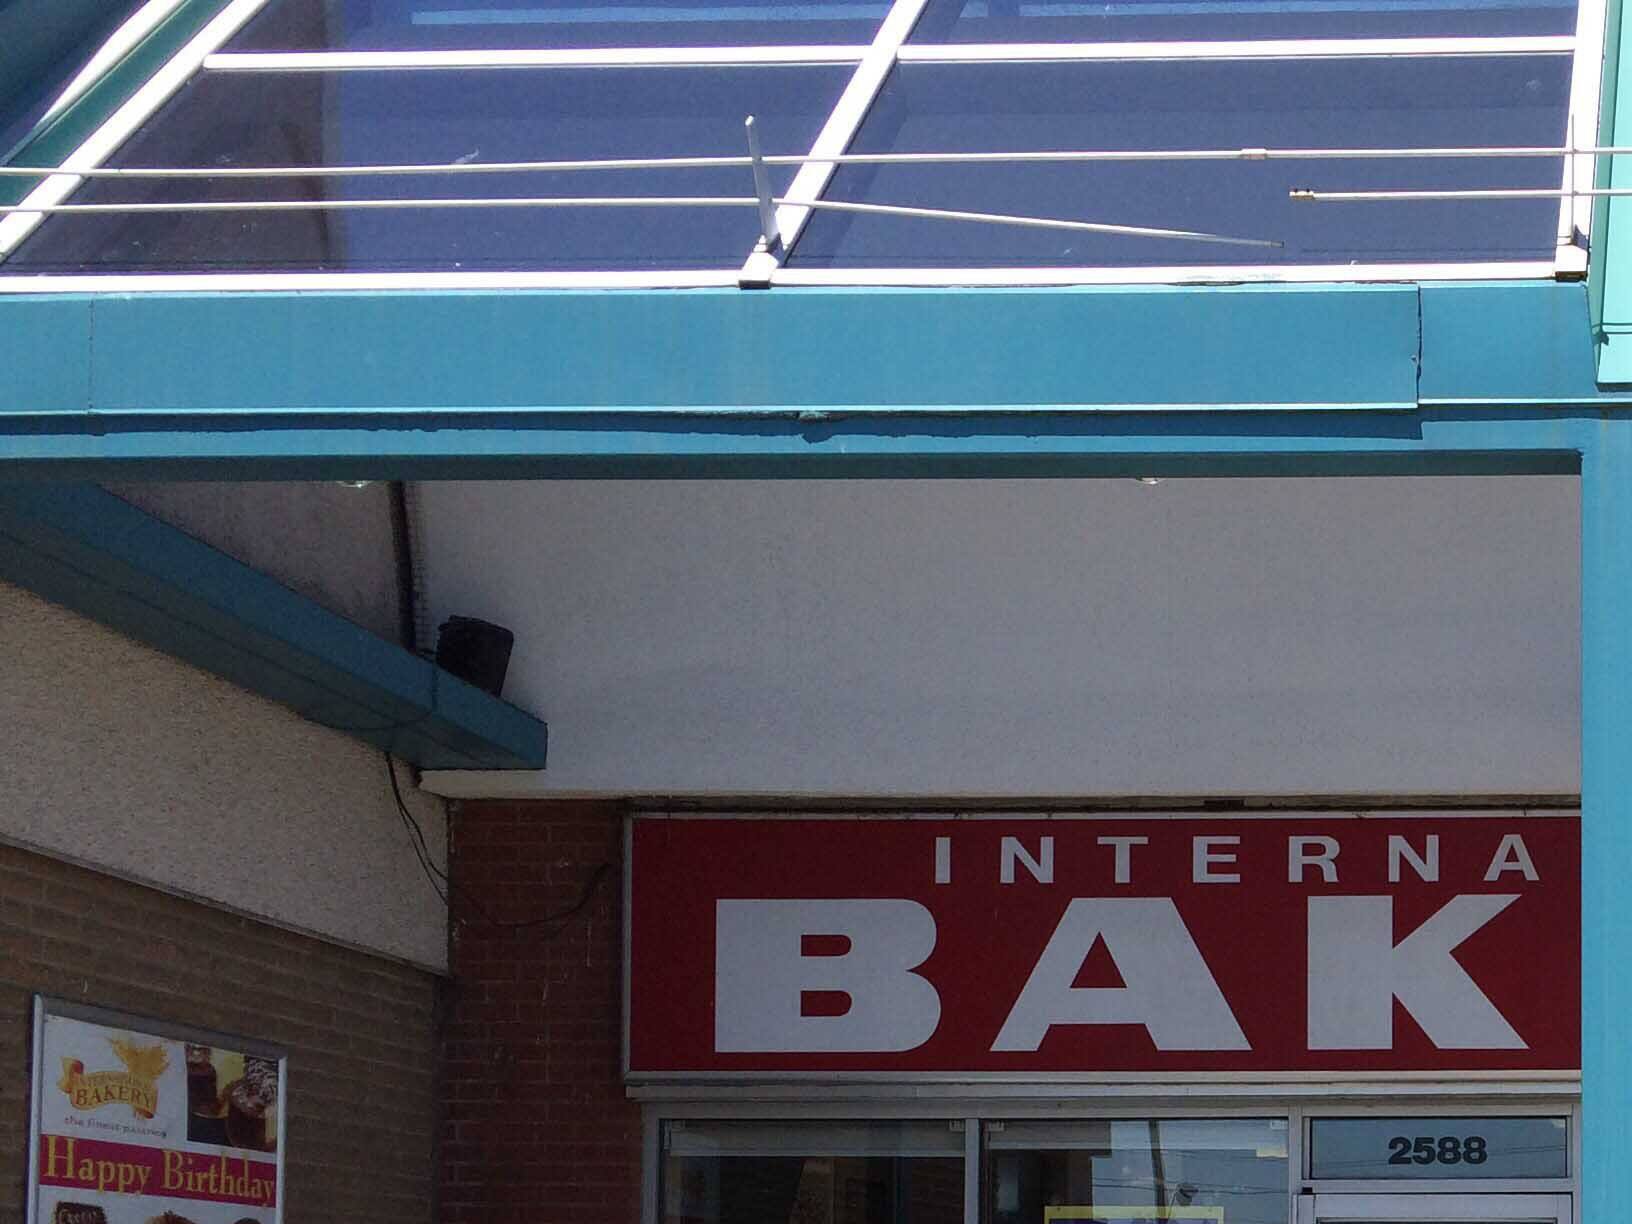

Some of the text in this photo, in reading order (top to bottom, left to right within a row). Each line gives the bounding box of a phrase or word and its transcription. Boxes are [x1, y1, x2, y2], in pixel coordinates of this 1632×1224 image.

[76, 1084, 156, 1109] BAKERY
[1388, 1136, 1488, 1165] 2588
[45, 1134, 275, 1208] Happy Birthday
